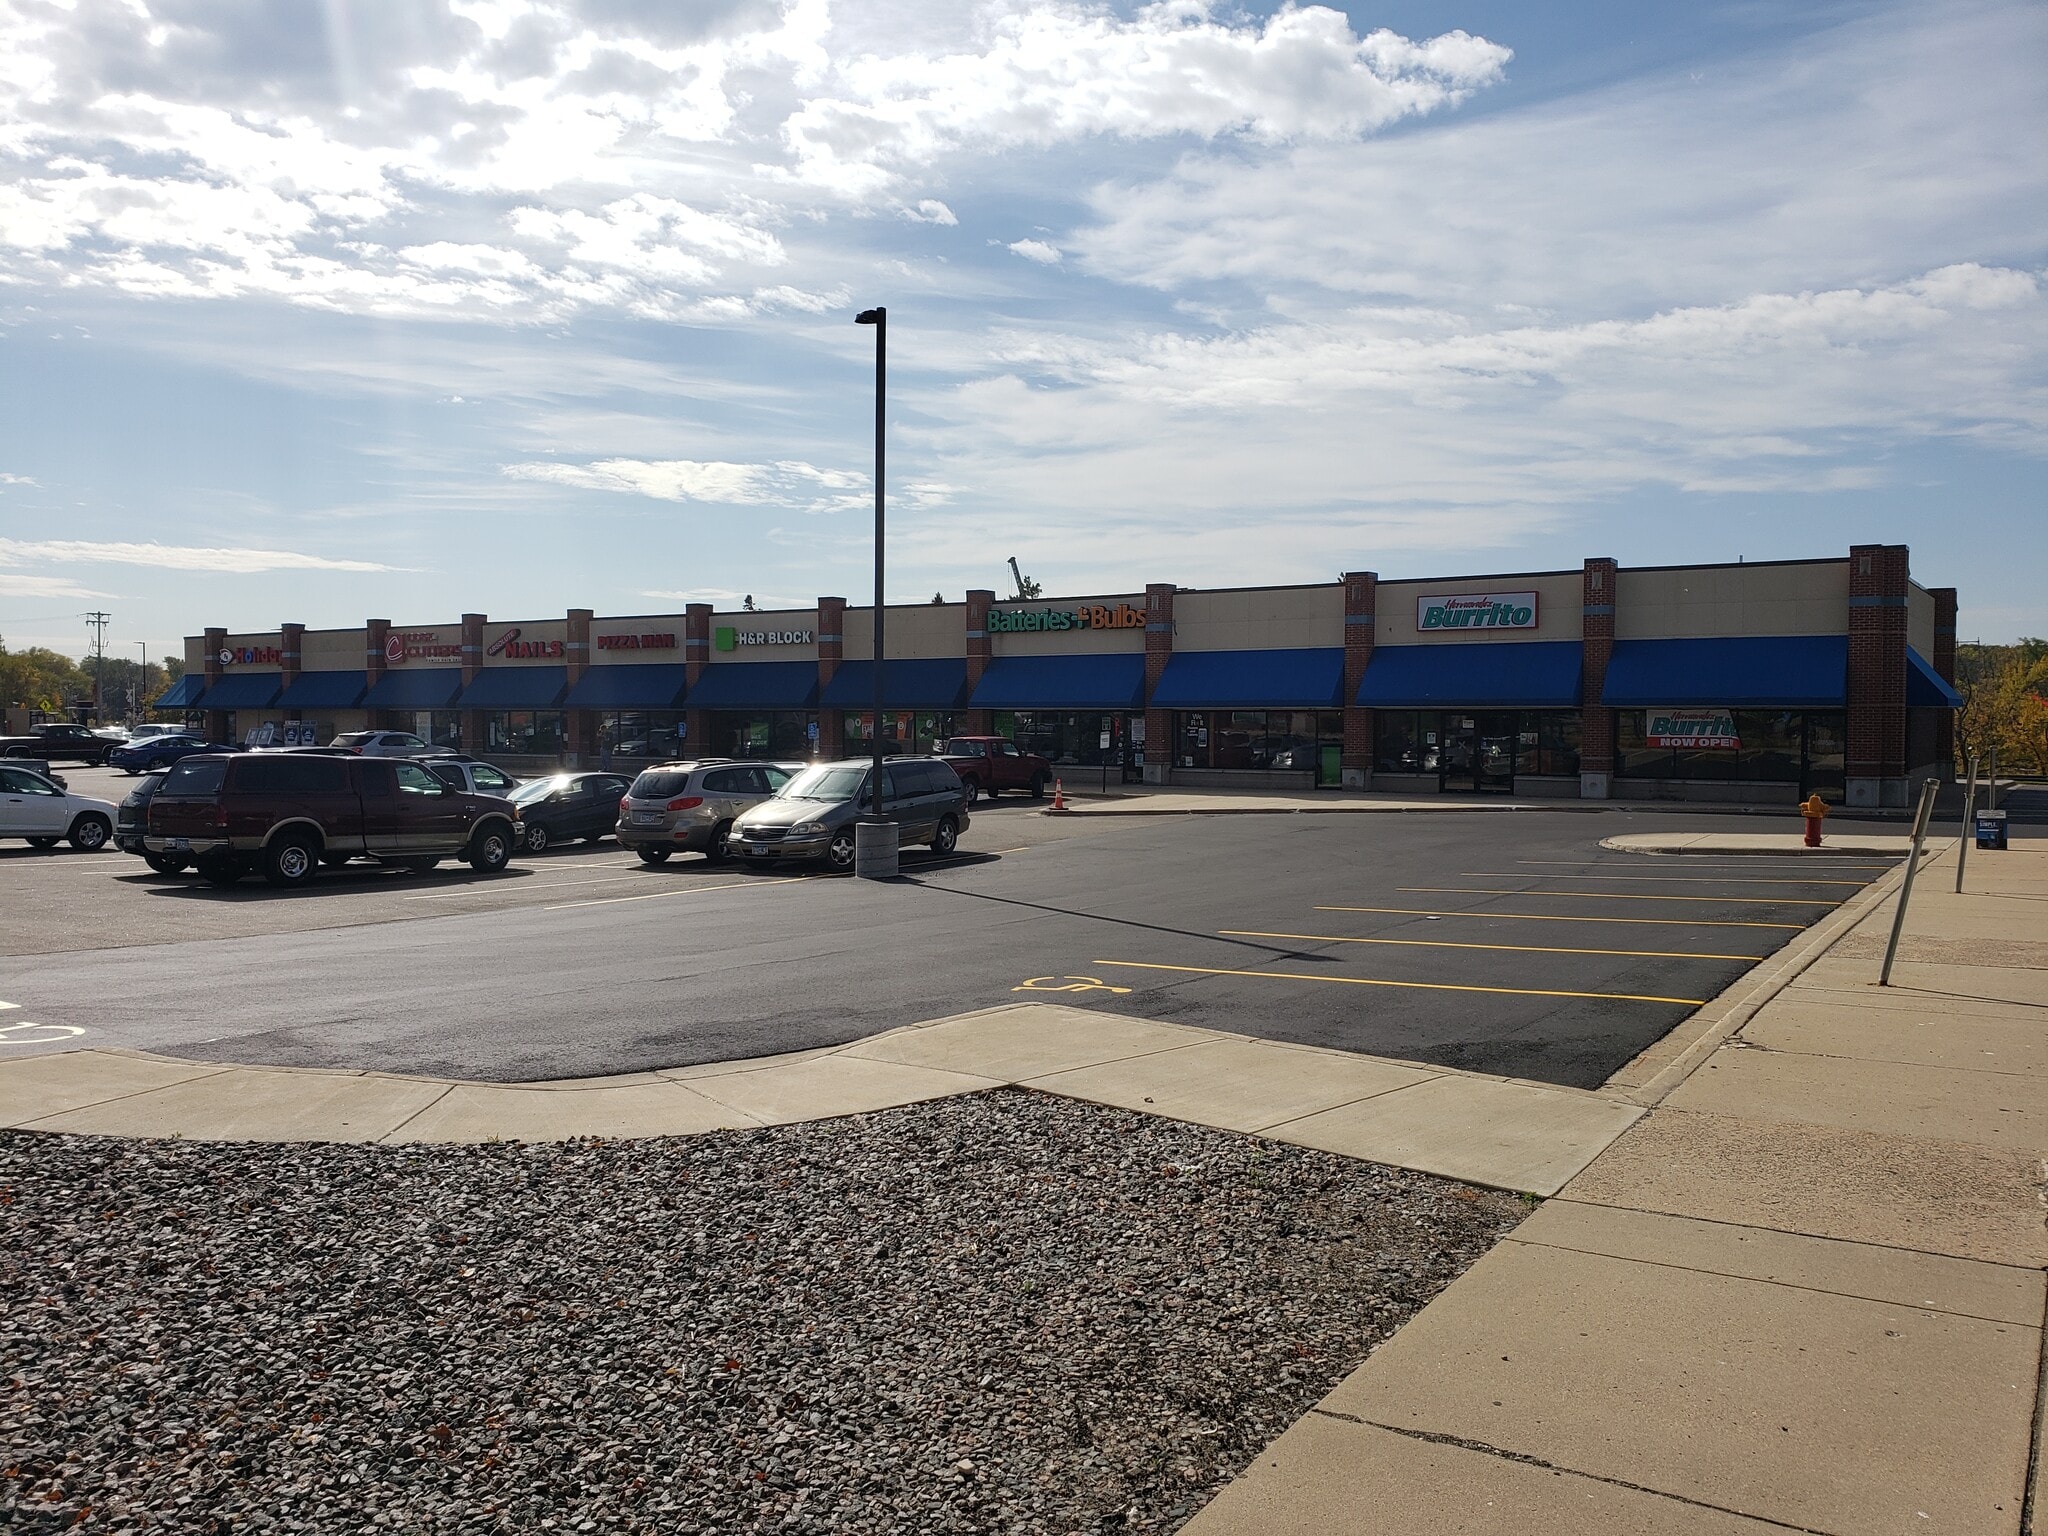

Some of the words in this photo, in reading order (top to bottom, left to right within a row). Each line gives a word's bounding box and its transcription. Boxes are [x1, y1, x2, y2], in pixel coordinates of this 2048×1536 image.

[1445, 597, 1494, 610] Hernandez
[987, 607, 1071, 633] Batteries
[1091, 604, 1147, 629] Bulbs
[1422, 603, 1532, 628] Burrito
[488, 630, 515, 655] ABSOLUTE
[597, 635, 640, 650] PIZZA
[739, 632, 765, 645] H&R
[768, 631, 811, 644] BLOCK
[505, 640, 564, 658] NAILS
[1660, 738, 1696, 747] NOW
